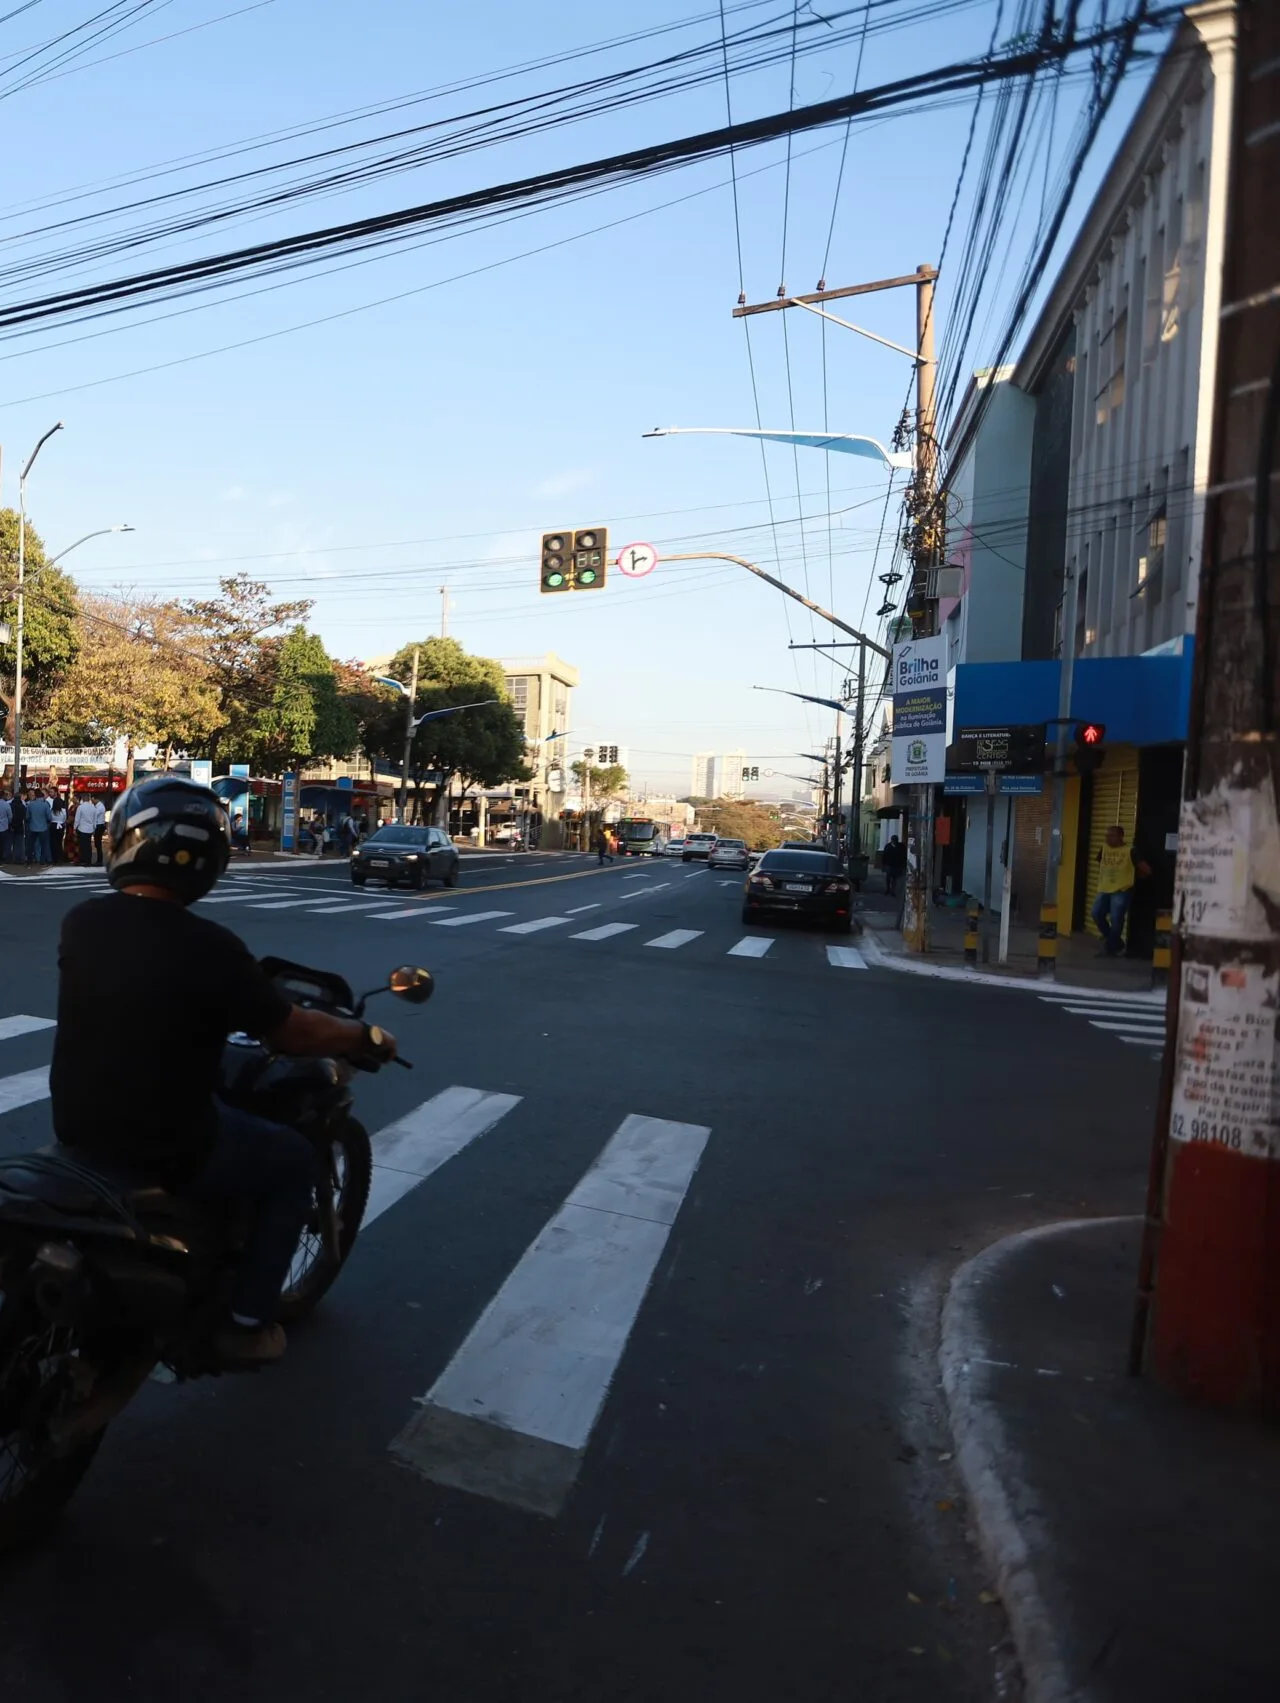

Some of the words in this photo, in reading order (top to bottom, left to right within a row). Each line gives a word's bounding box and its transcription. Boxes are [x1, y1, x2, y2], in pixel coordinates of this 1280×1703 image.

[900, 658, 938, 675] Brilha
[900, 671, 938, 686] Goiânia
[64, 747, 113, 756] COMPROMISSO
